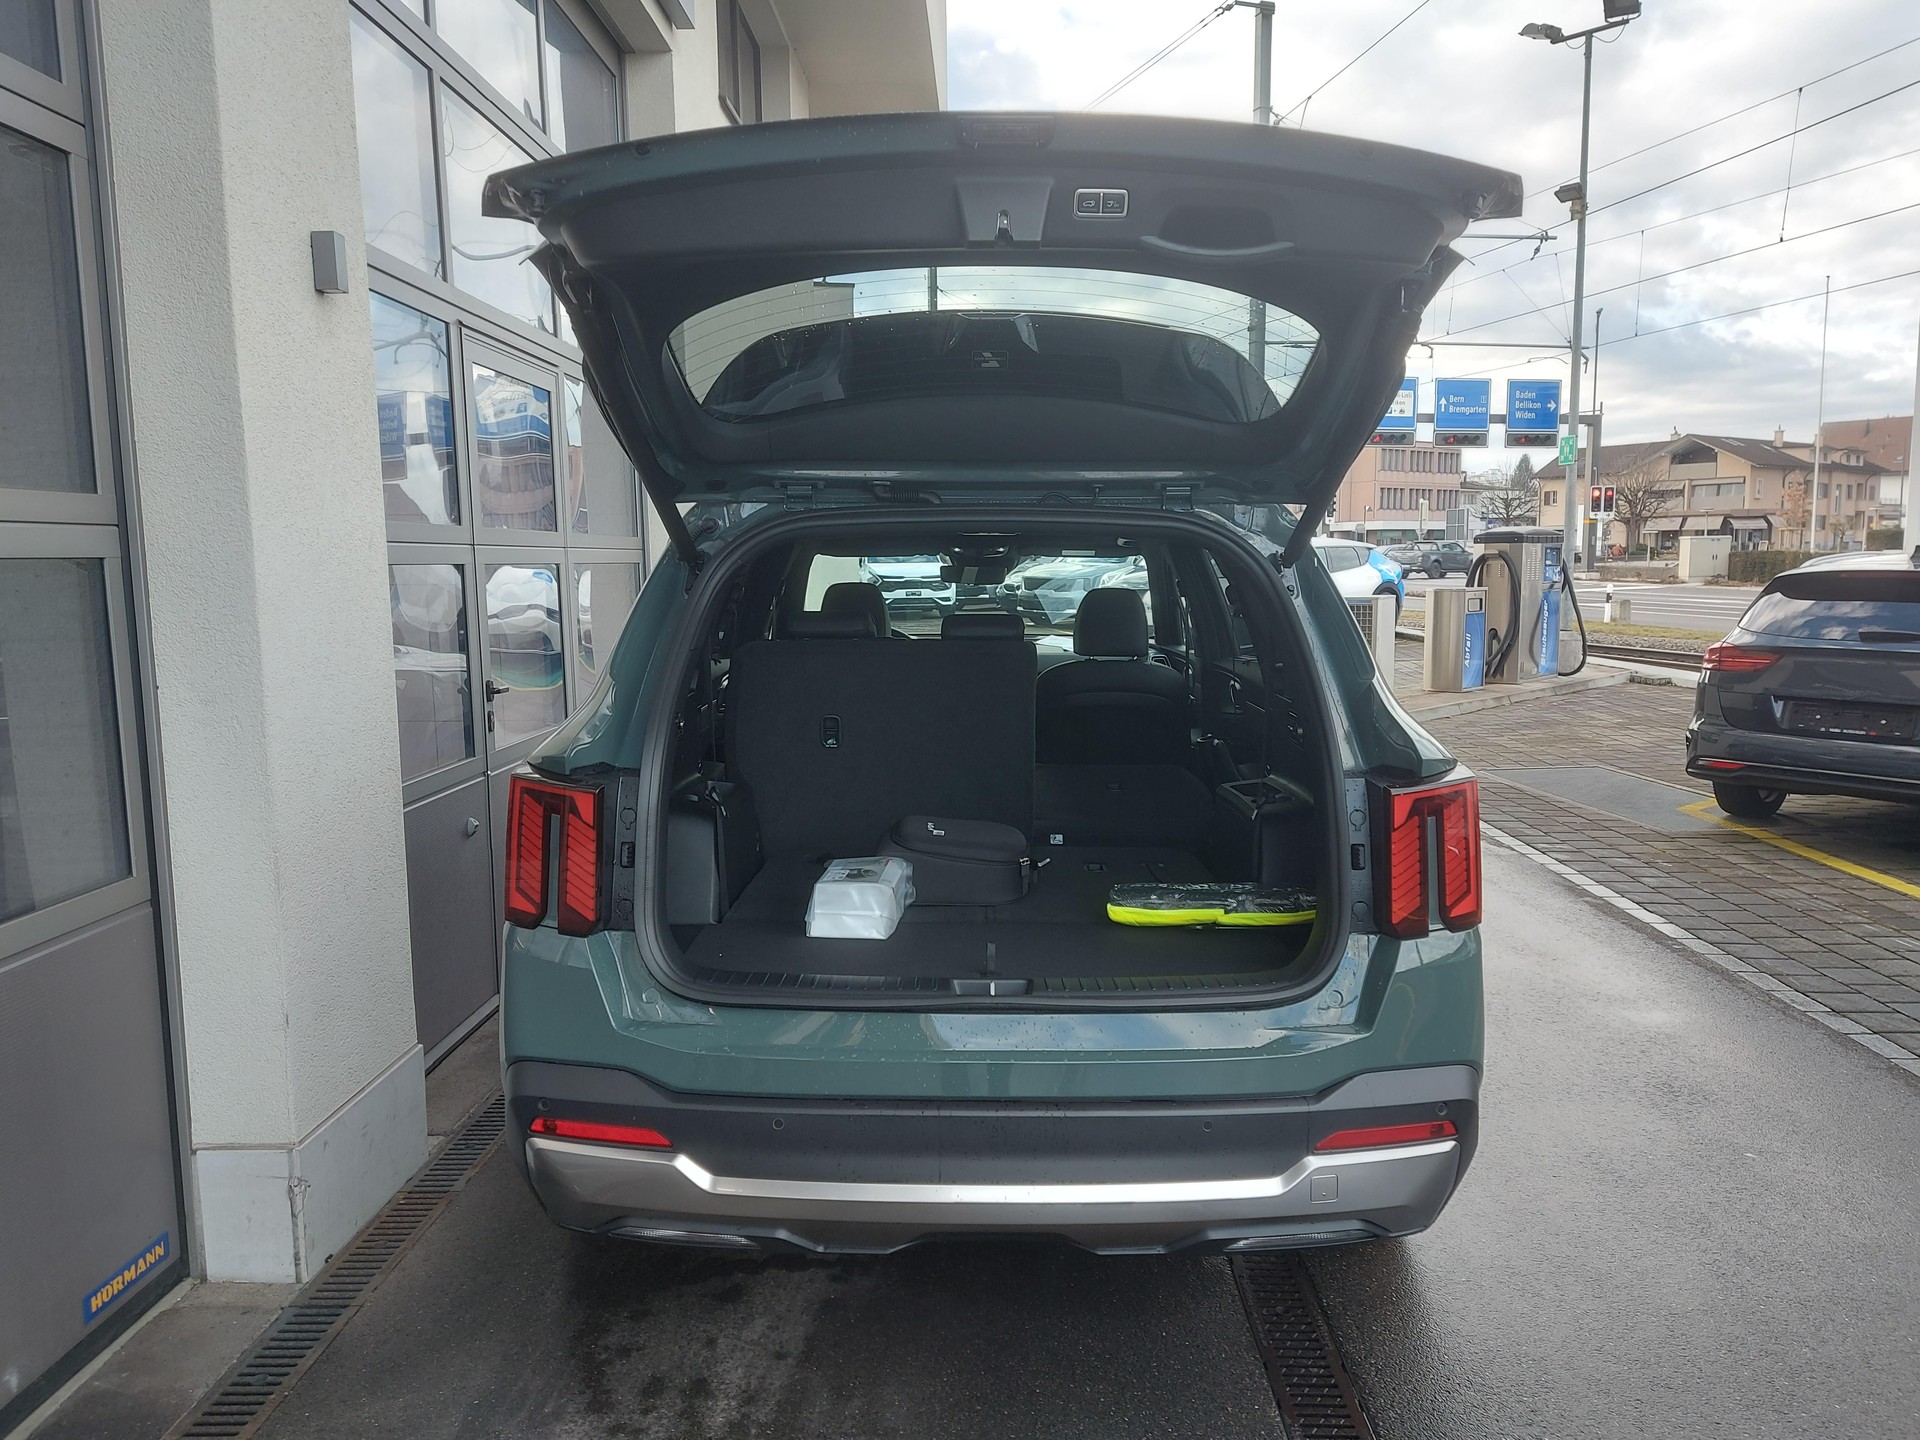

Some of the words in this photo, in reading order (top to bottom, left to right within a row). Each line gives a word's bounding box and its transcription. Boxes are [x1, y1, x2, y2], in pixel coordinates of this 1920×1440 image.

[1449, 395, 1465, 403] Bern
[1515, 390, 1536, 399] Baden
[1515, 400, 1542, 409] Bellikon
[1449, 405, 1487, 415] Bremgarten
[1515, 410, 1536, 419] Widen
[1540, 599, 1549, 667] Staubsauger
[1463, 632, 1472, 669] Abfall
[90, 1240, 165, 1313] HÖRMANN
